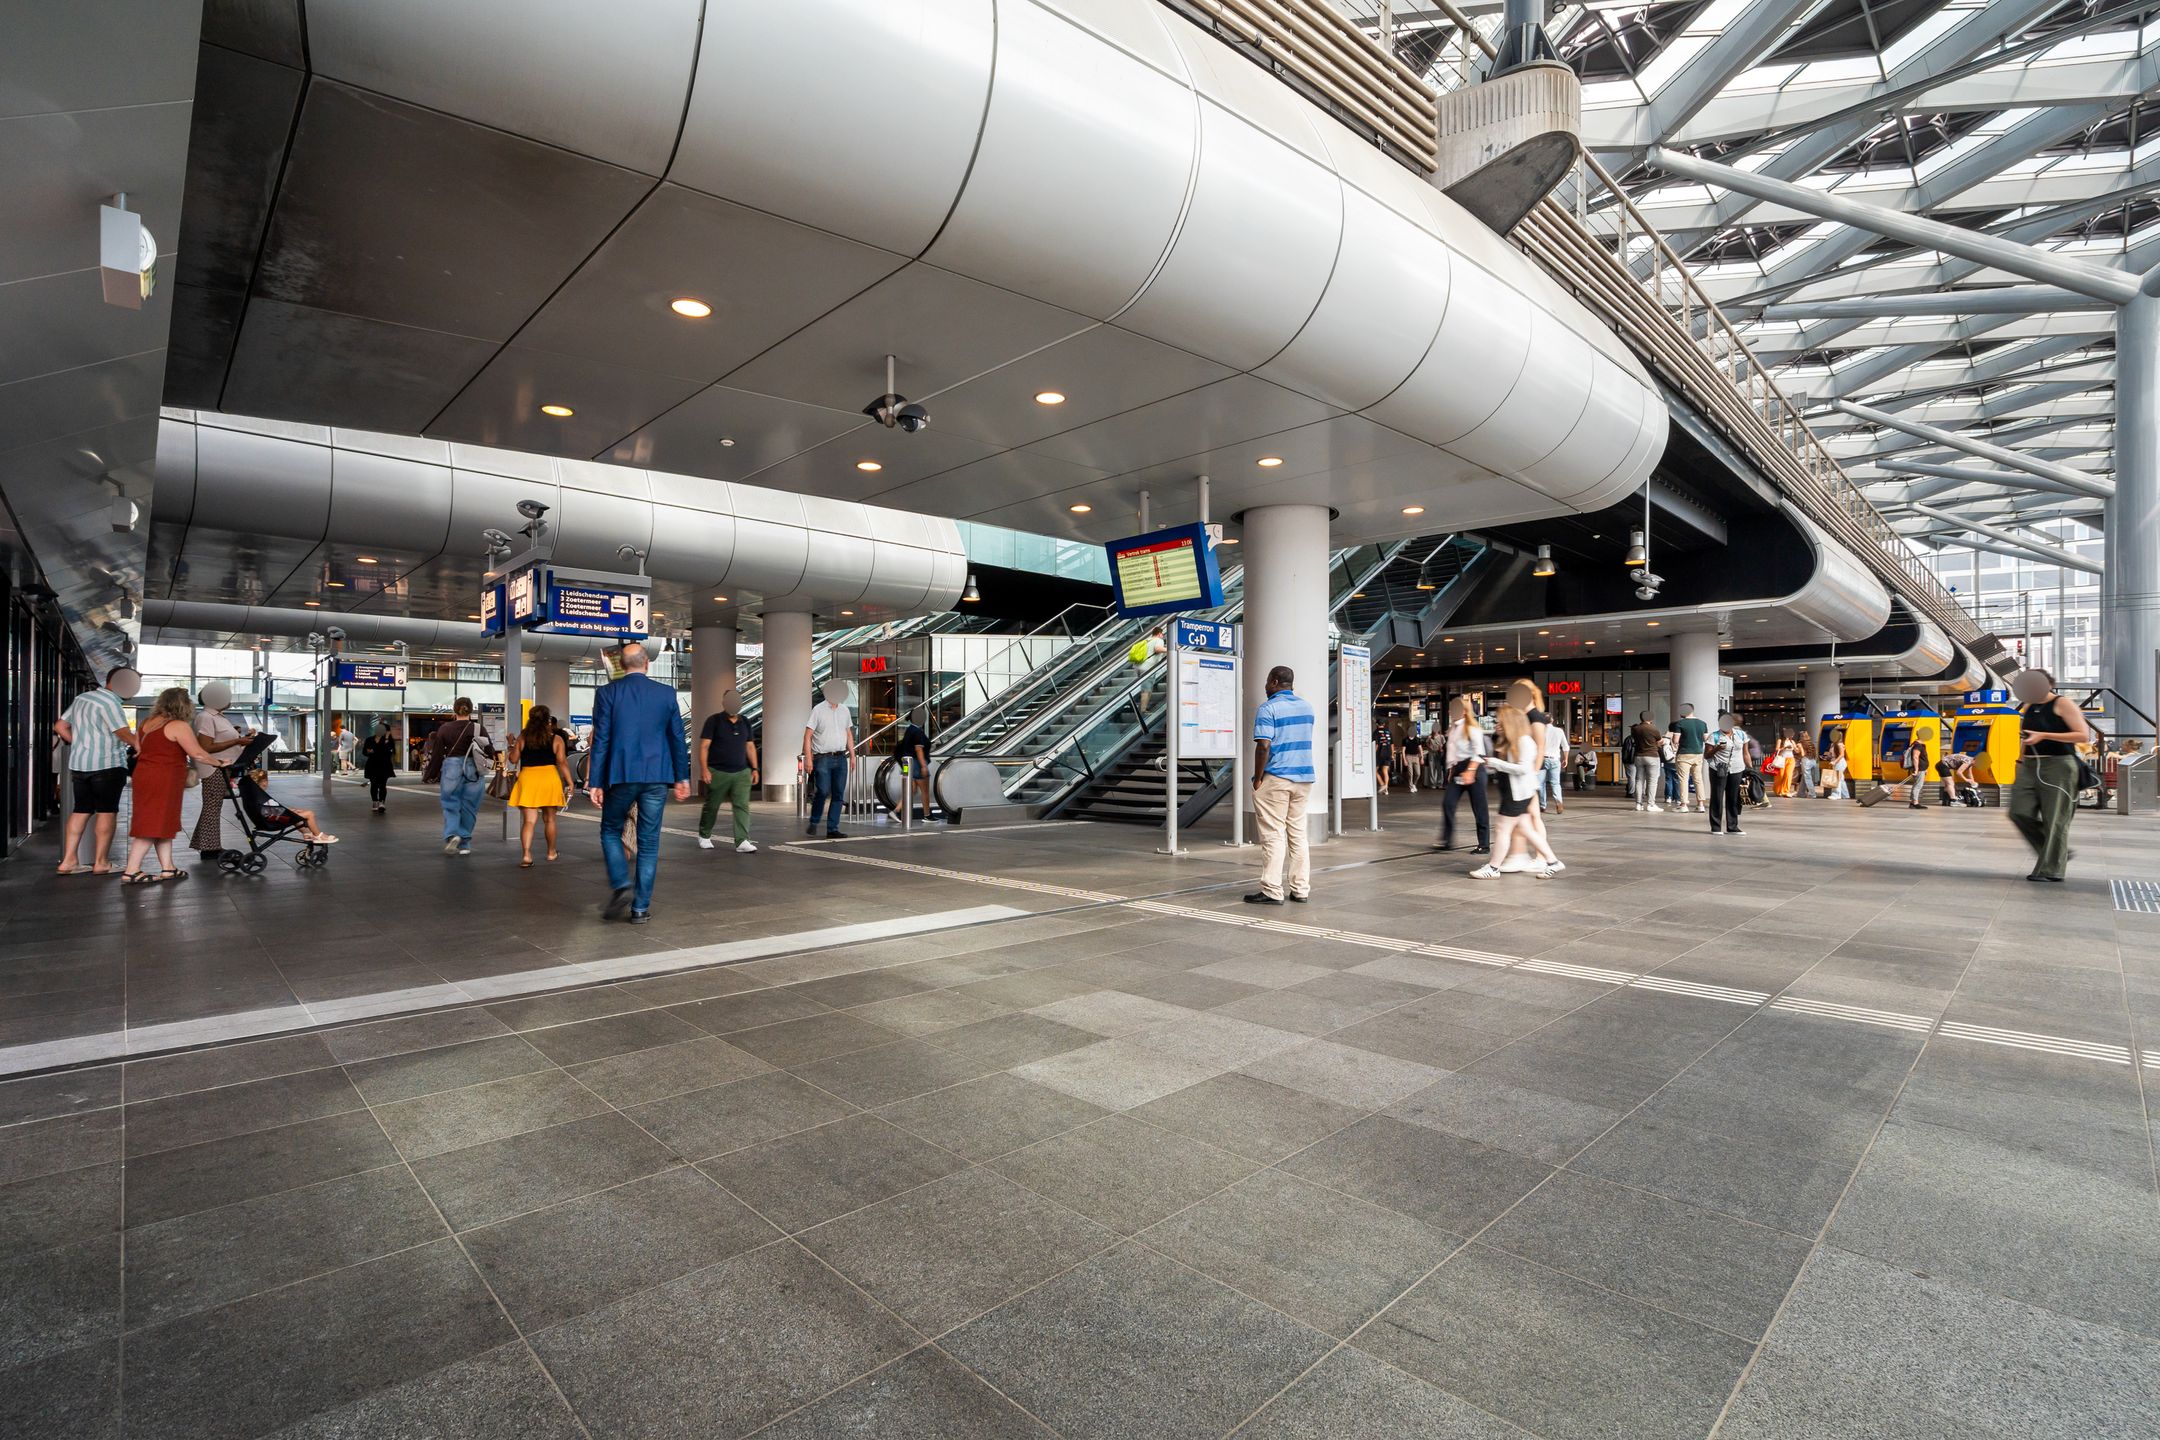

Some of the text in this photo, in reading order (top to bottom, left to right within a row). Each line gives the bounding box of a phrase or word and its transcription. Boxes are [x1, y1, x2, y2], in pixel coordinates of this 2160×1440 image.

[566, 590, 610, 600] Leidschendam
[566, 596, 602, 604] Zoetermeer
[566, 602, 602, 611] Zoetermeer
[566, 608, 610, 618] Leidschendam
[1180, 620, 1214, 632] Tramperron
[1188, 632, 1206, 646] C+D
[862, 656, 886, 672] KIOSK
[1548, 681, 1580, 694] KIOSK
